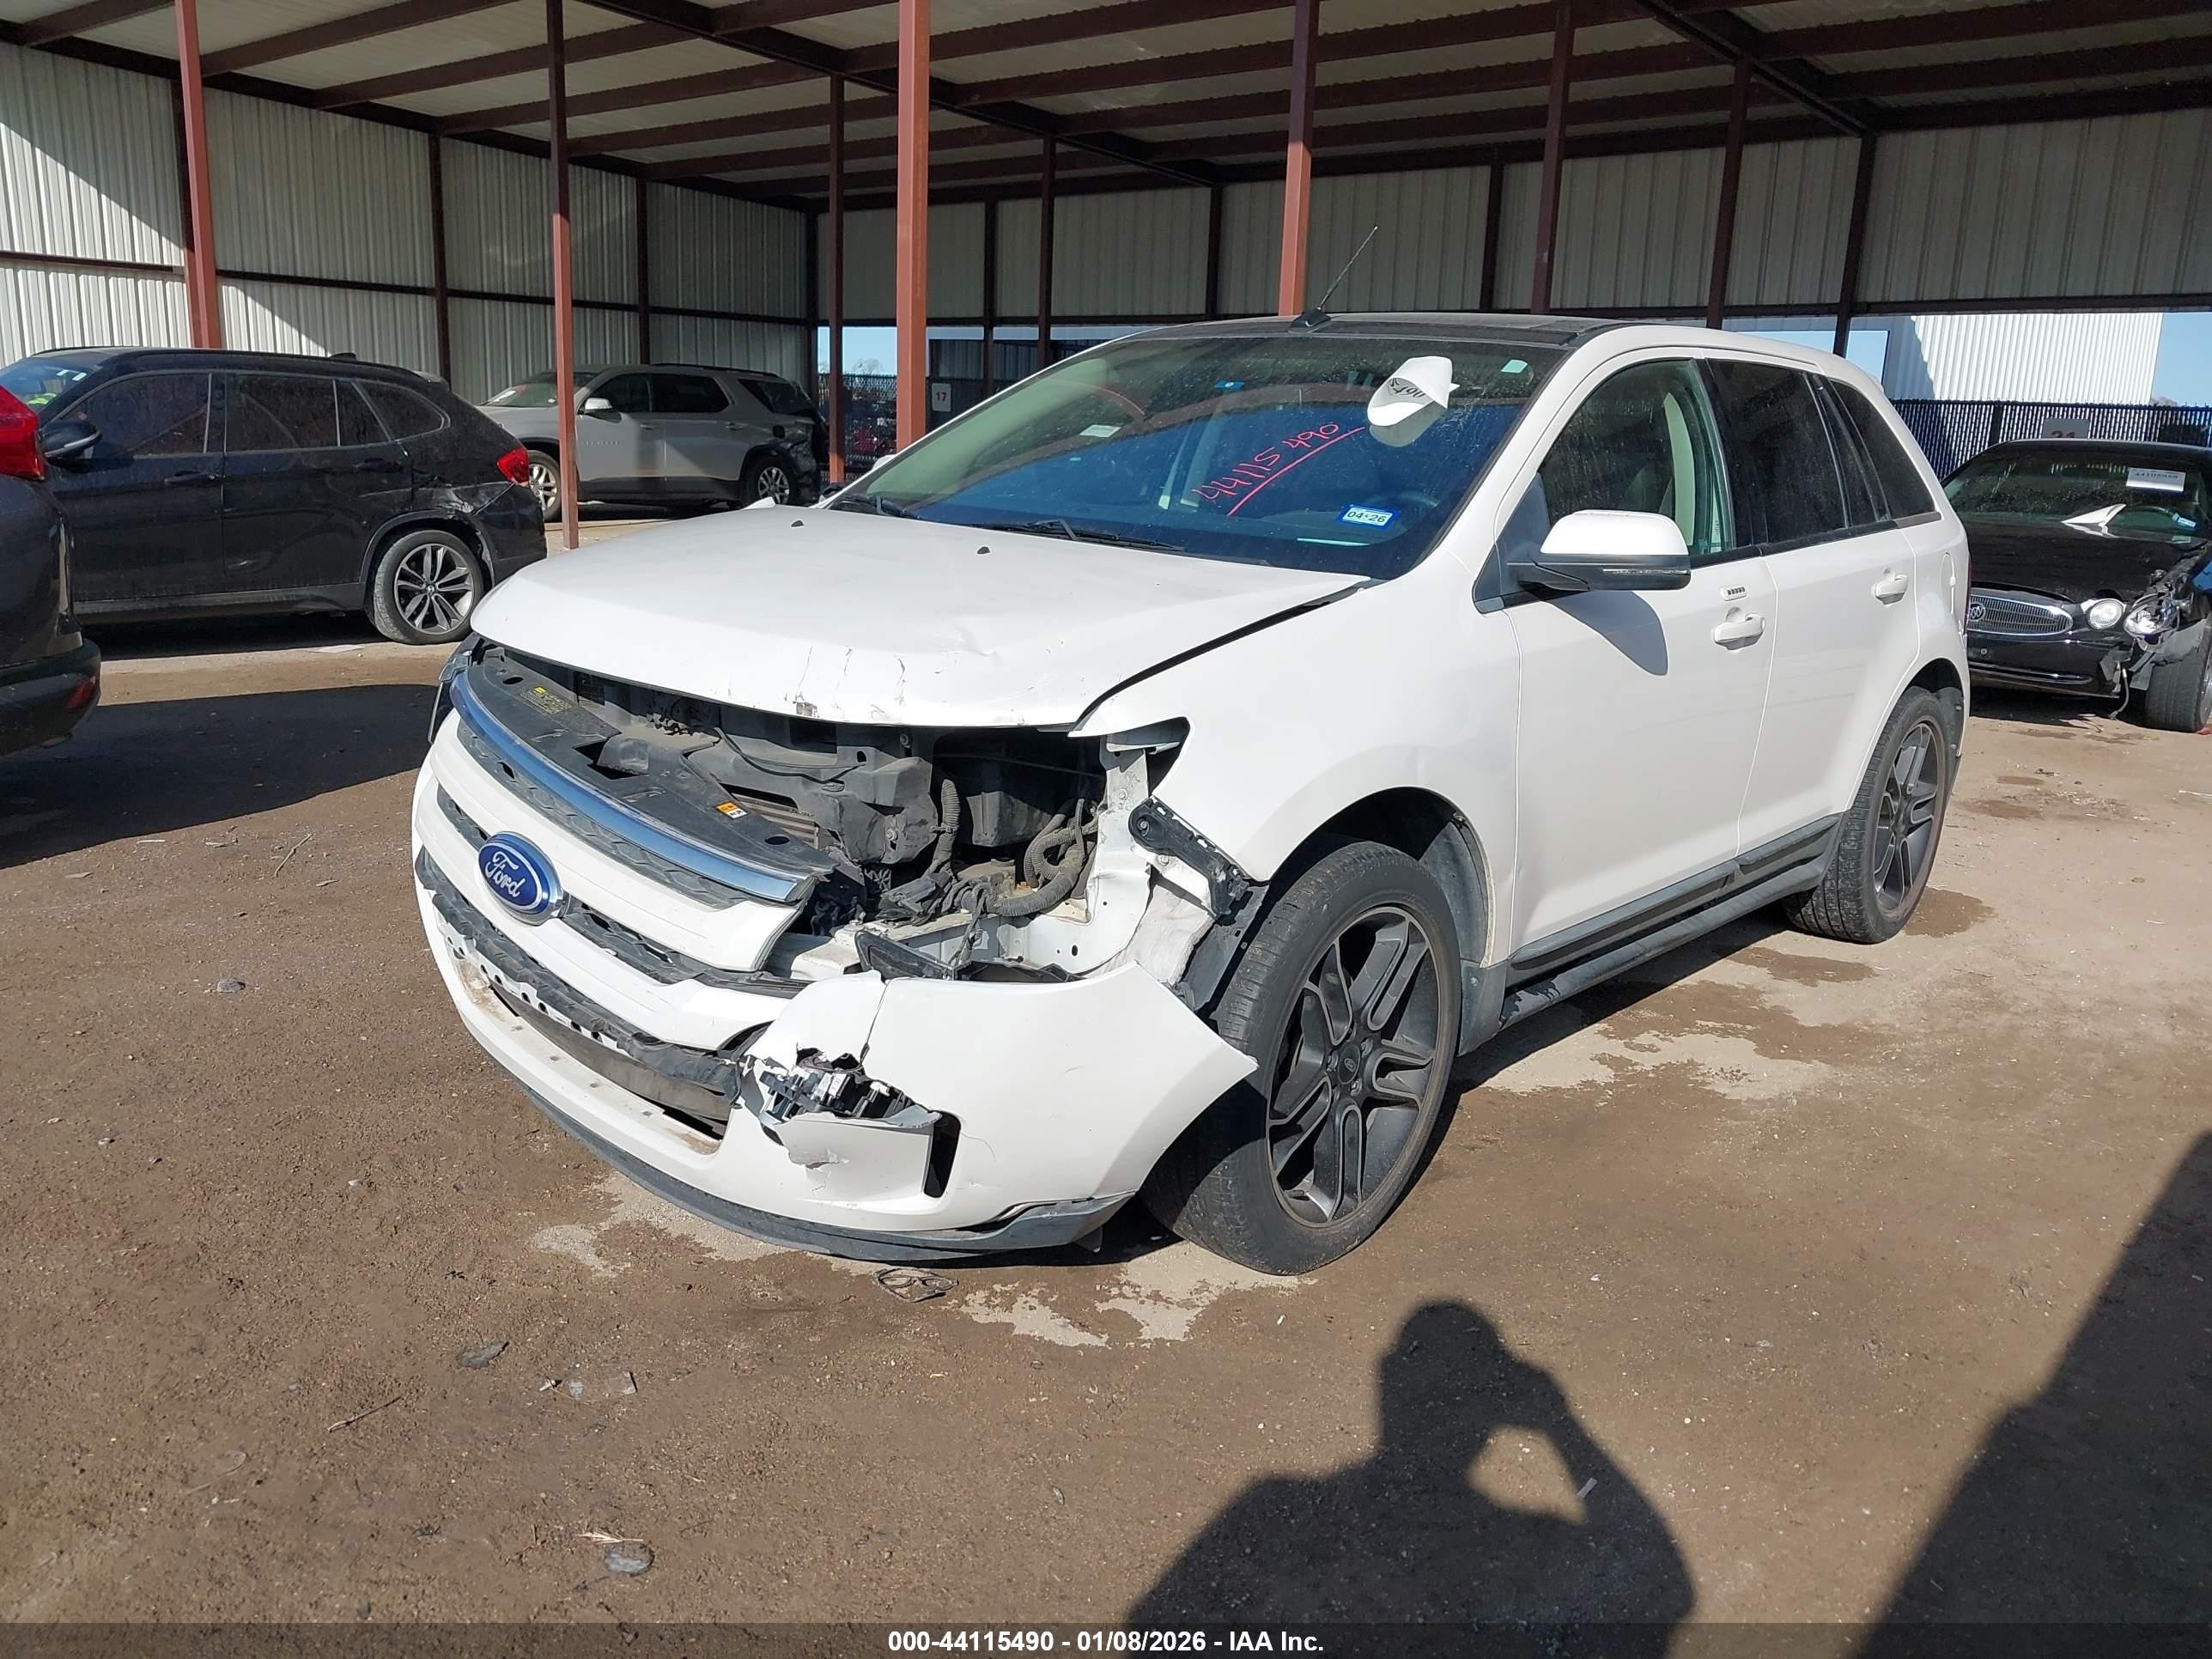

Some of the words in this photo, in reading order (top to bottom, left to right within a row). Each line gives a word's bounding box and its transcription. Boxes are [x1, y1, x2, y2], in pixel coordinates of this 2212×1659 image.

[936, 391, 947, 402] 17
[1191, 447, 1281, 500] 44115
[1281, 422, 1340, 448] 490
[484, 851, 526, 898] Ford
